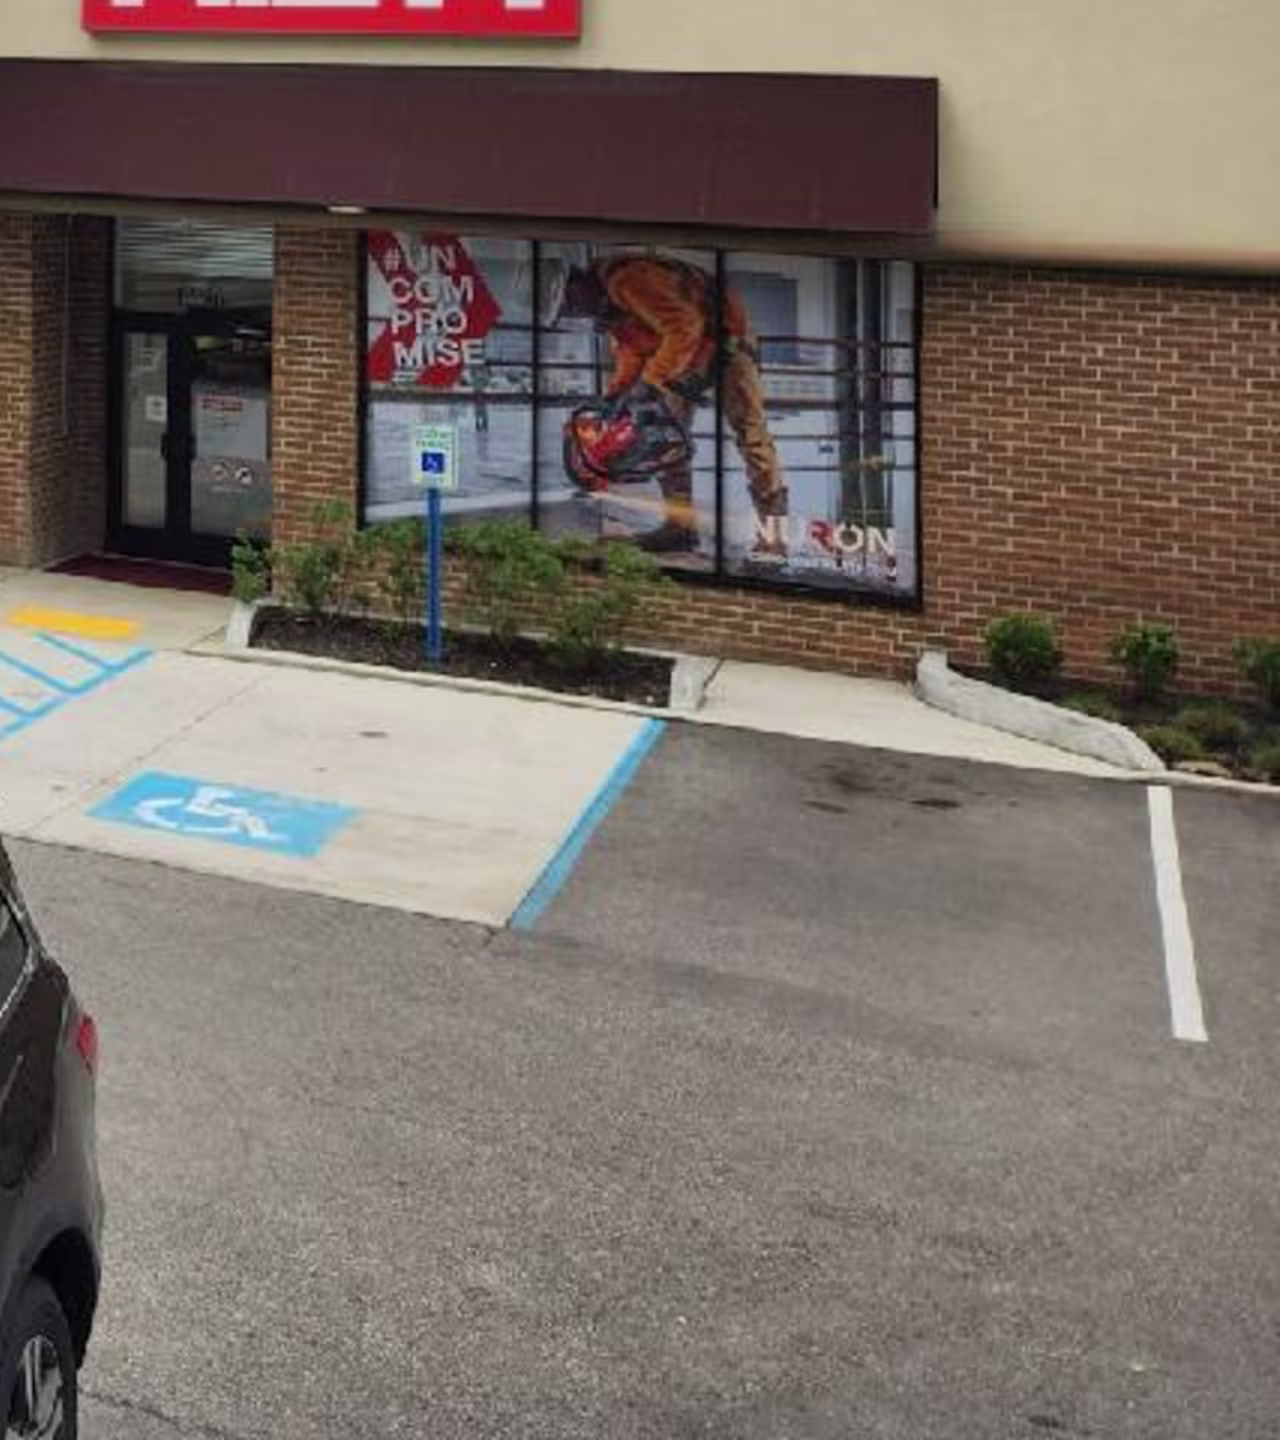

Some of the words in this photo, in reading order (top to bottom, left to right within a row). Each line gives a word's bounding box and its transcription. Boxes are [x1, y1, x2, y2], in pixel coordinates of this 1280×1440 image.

[389, 275, 475, 304] COM
[391, 308, 468, 335] PRO
[392, 337, 486, 367] MISE
